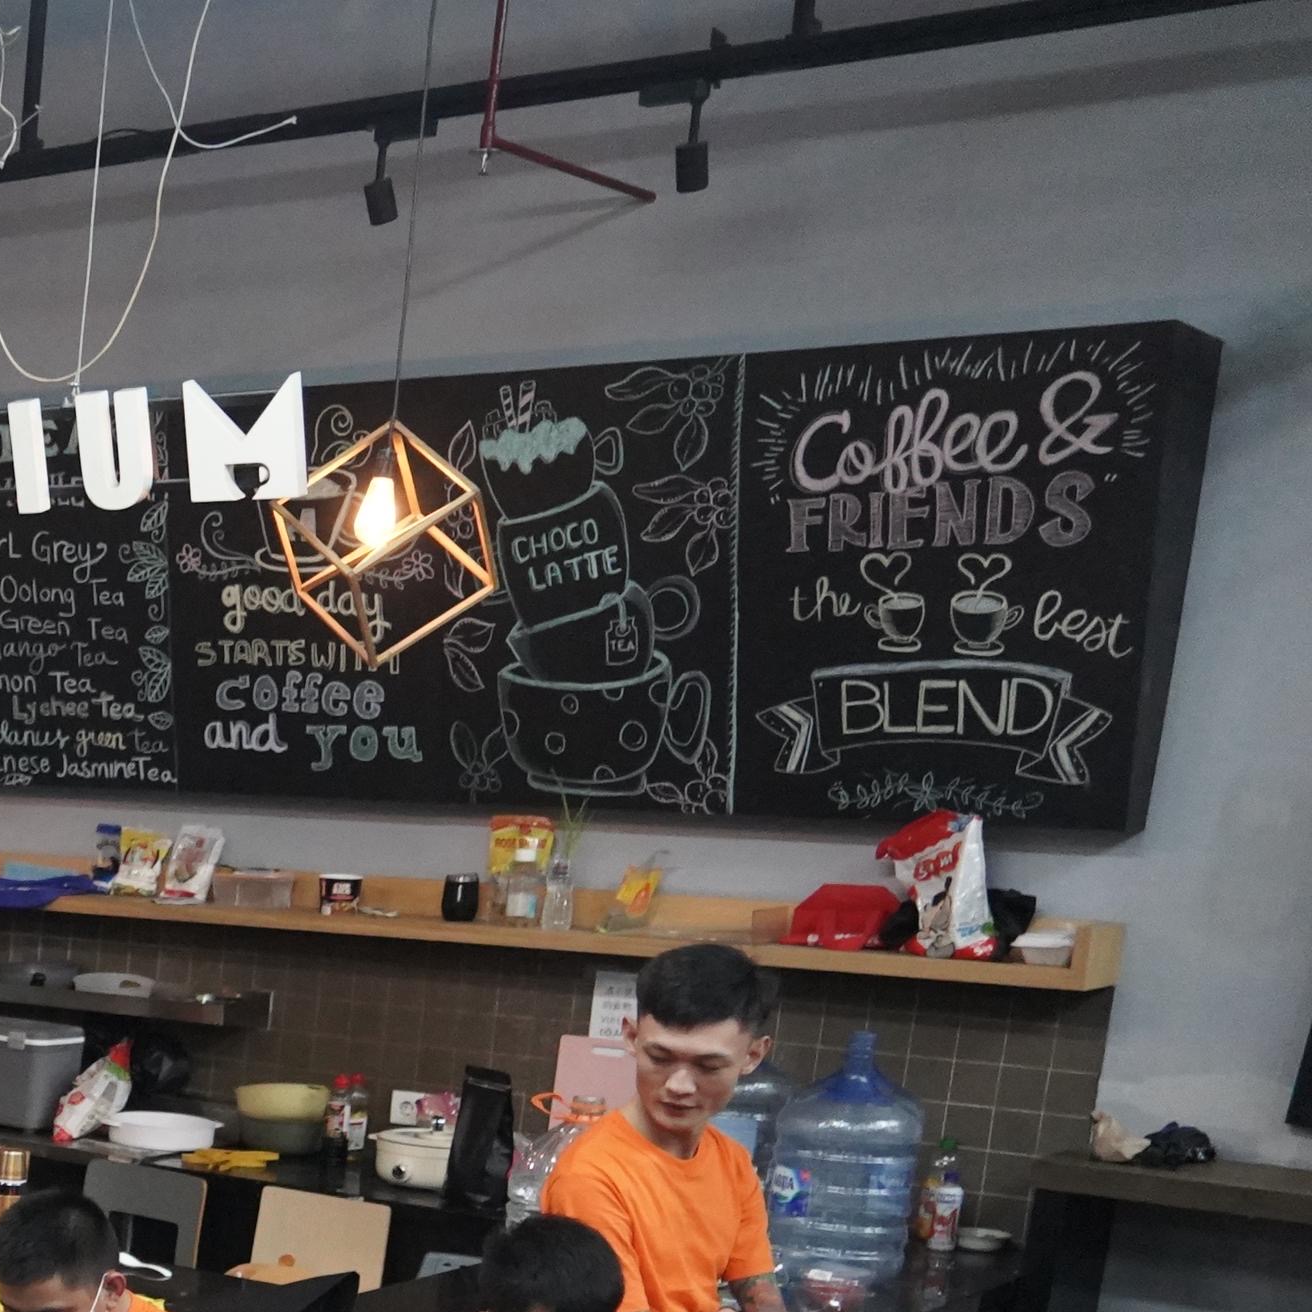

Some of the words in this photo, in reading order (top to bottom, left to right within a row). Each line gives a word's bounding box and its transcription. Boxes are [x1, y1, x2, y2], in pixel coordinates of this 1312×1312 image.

[790, 387, 1028, 495] Coffee
[1037, 370, 1119, 466] &
[32, 531, 108, 583] Grey
[511, 518, 599, 564] CHOCO
[528, 545, 622, 591] LATTE
[0, 575, 75, 617] Oolong
[89, 578, 125, 606] Tea
[221, 581, 306, 633] good
[316, 581, 392, 644] day
[790, 575, 861, 622] the
[1034, 590, 1134, 658] best
[88, 618, 129, 643] Tea
[609, 639, 636, 651] TEA
[70, 642, 118, 667] Tea
[194, 638, 306, 667] STARTS
[48, 671, 97, 694] Tea
[12, 694, 88, 725] Lychee
[91, 691, 144, 722] Tea
[841, 678, 1054, 735] BLEND
[76, 728, 126, 757] green
[128, 728, 169, 753] tea
[204, 713, 288, 754] and
[305, 725, 423, 772] you
[56, 753, 136, 778] Jasmine
[131, 757, 178, 783] Tea
